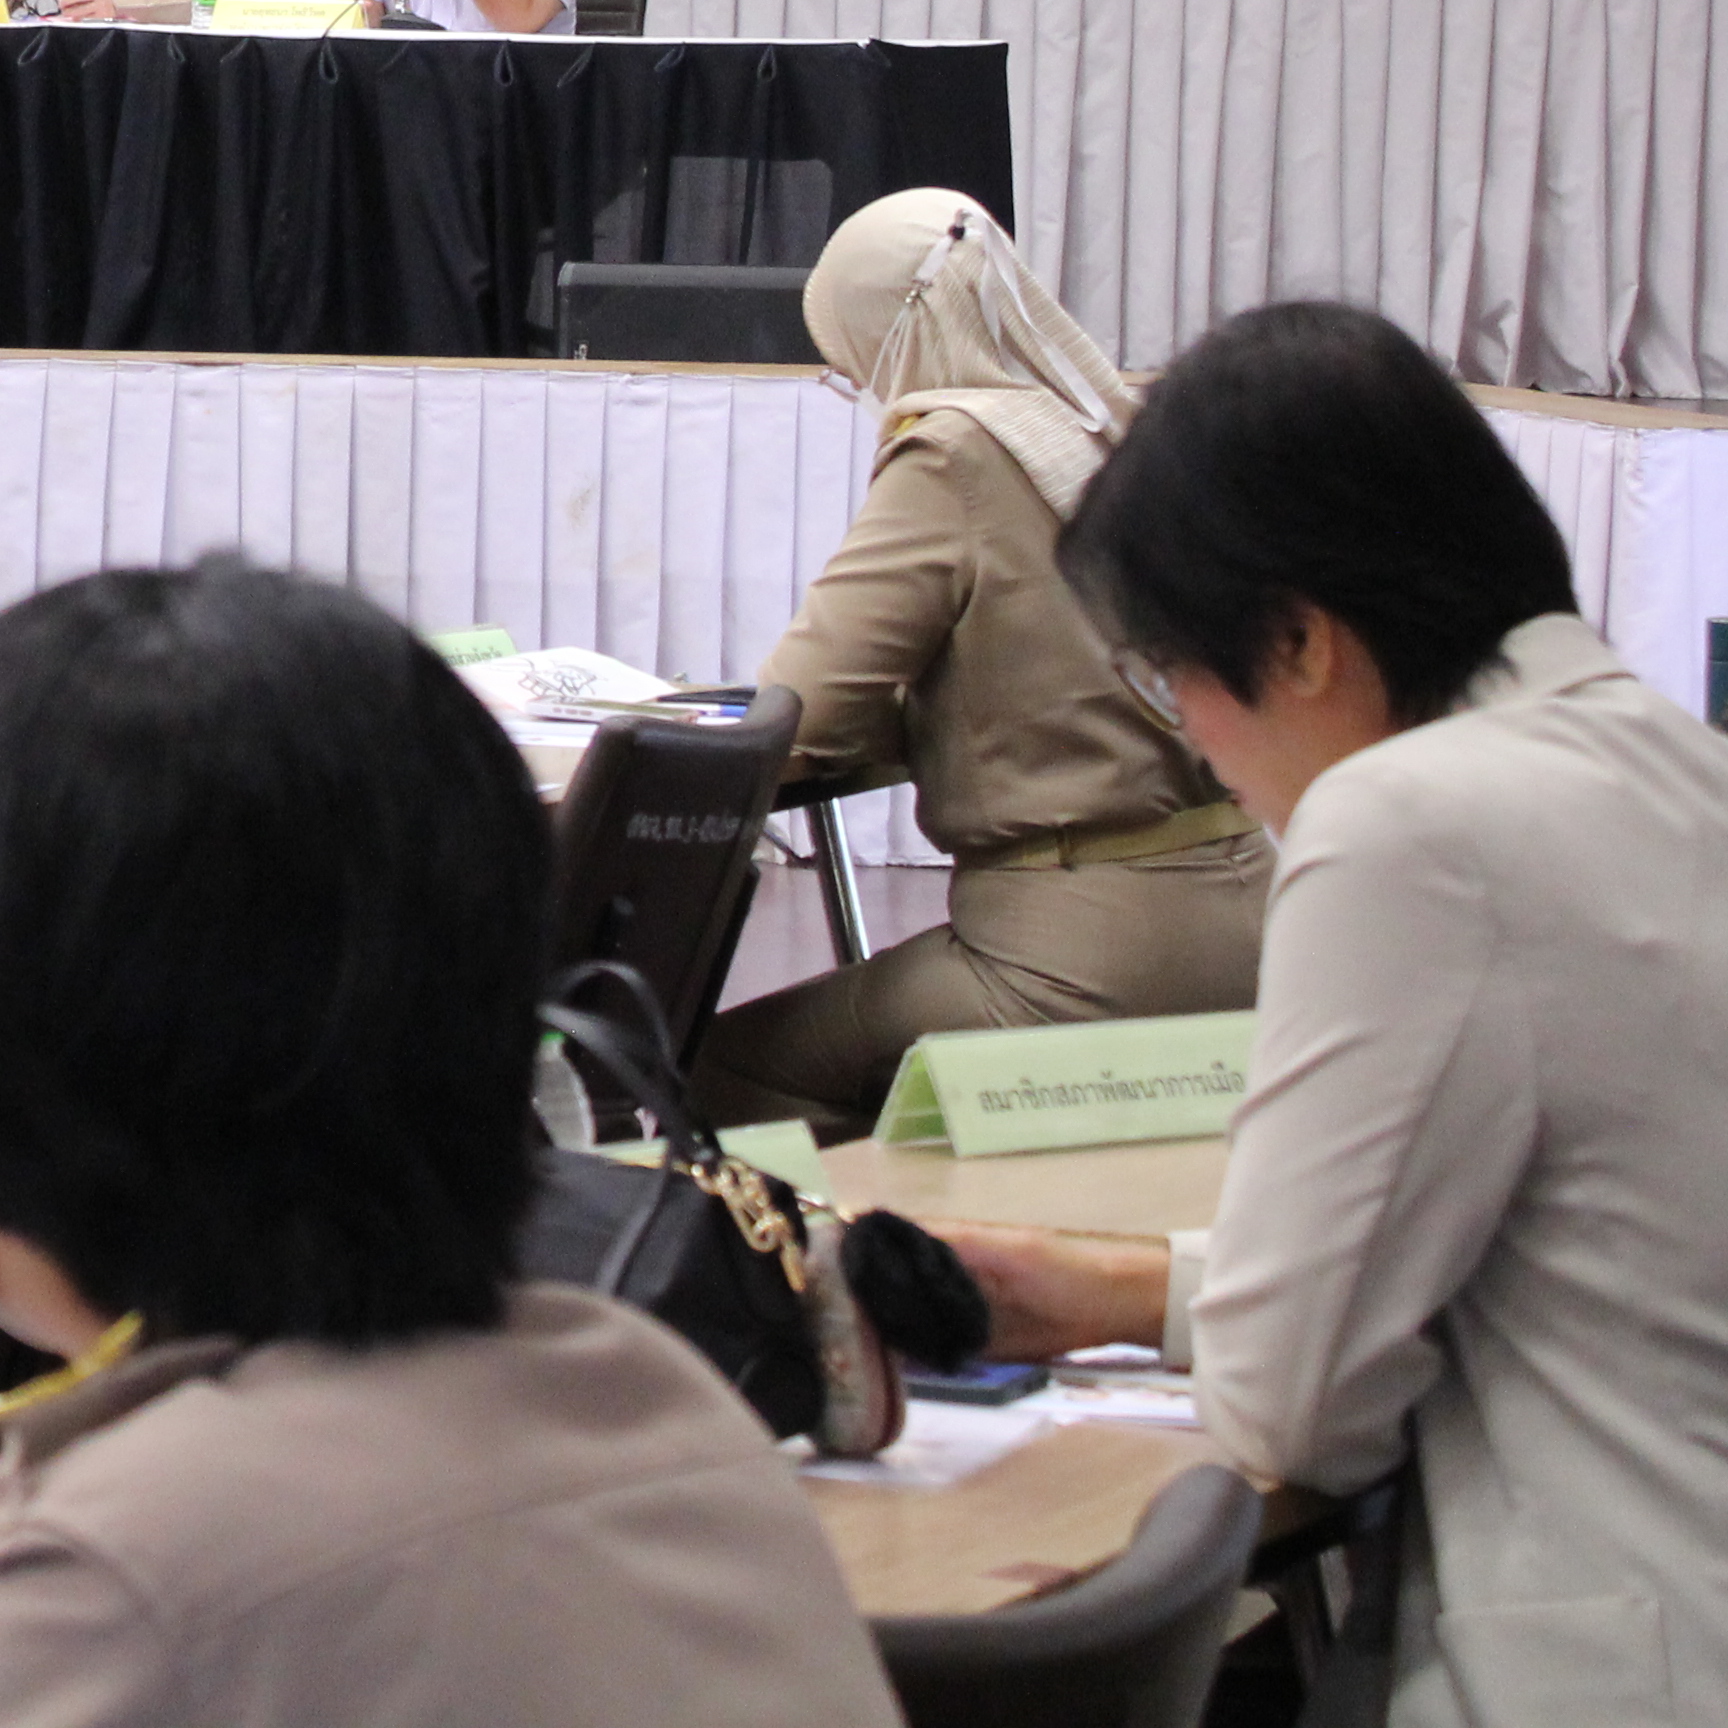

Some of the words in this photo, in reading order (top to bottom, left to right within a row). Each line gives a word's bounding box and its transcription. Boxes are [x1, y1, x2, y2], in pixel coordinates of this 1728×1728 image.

[977, 1059, 1246, 1114] สมาชิกสภาพัฒนาการเมือ
